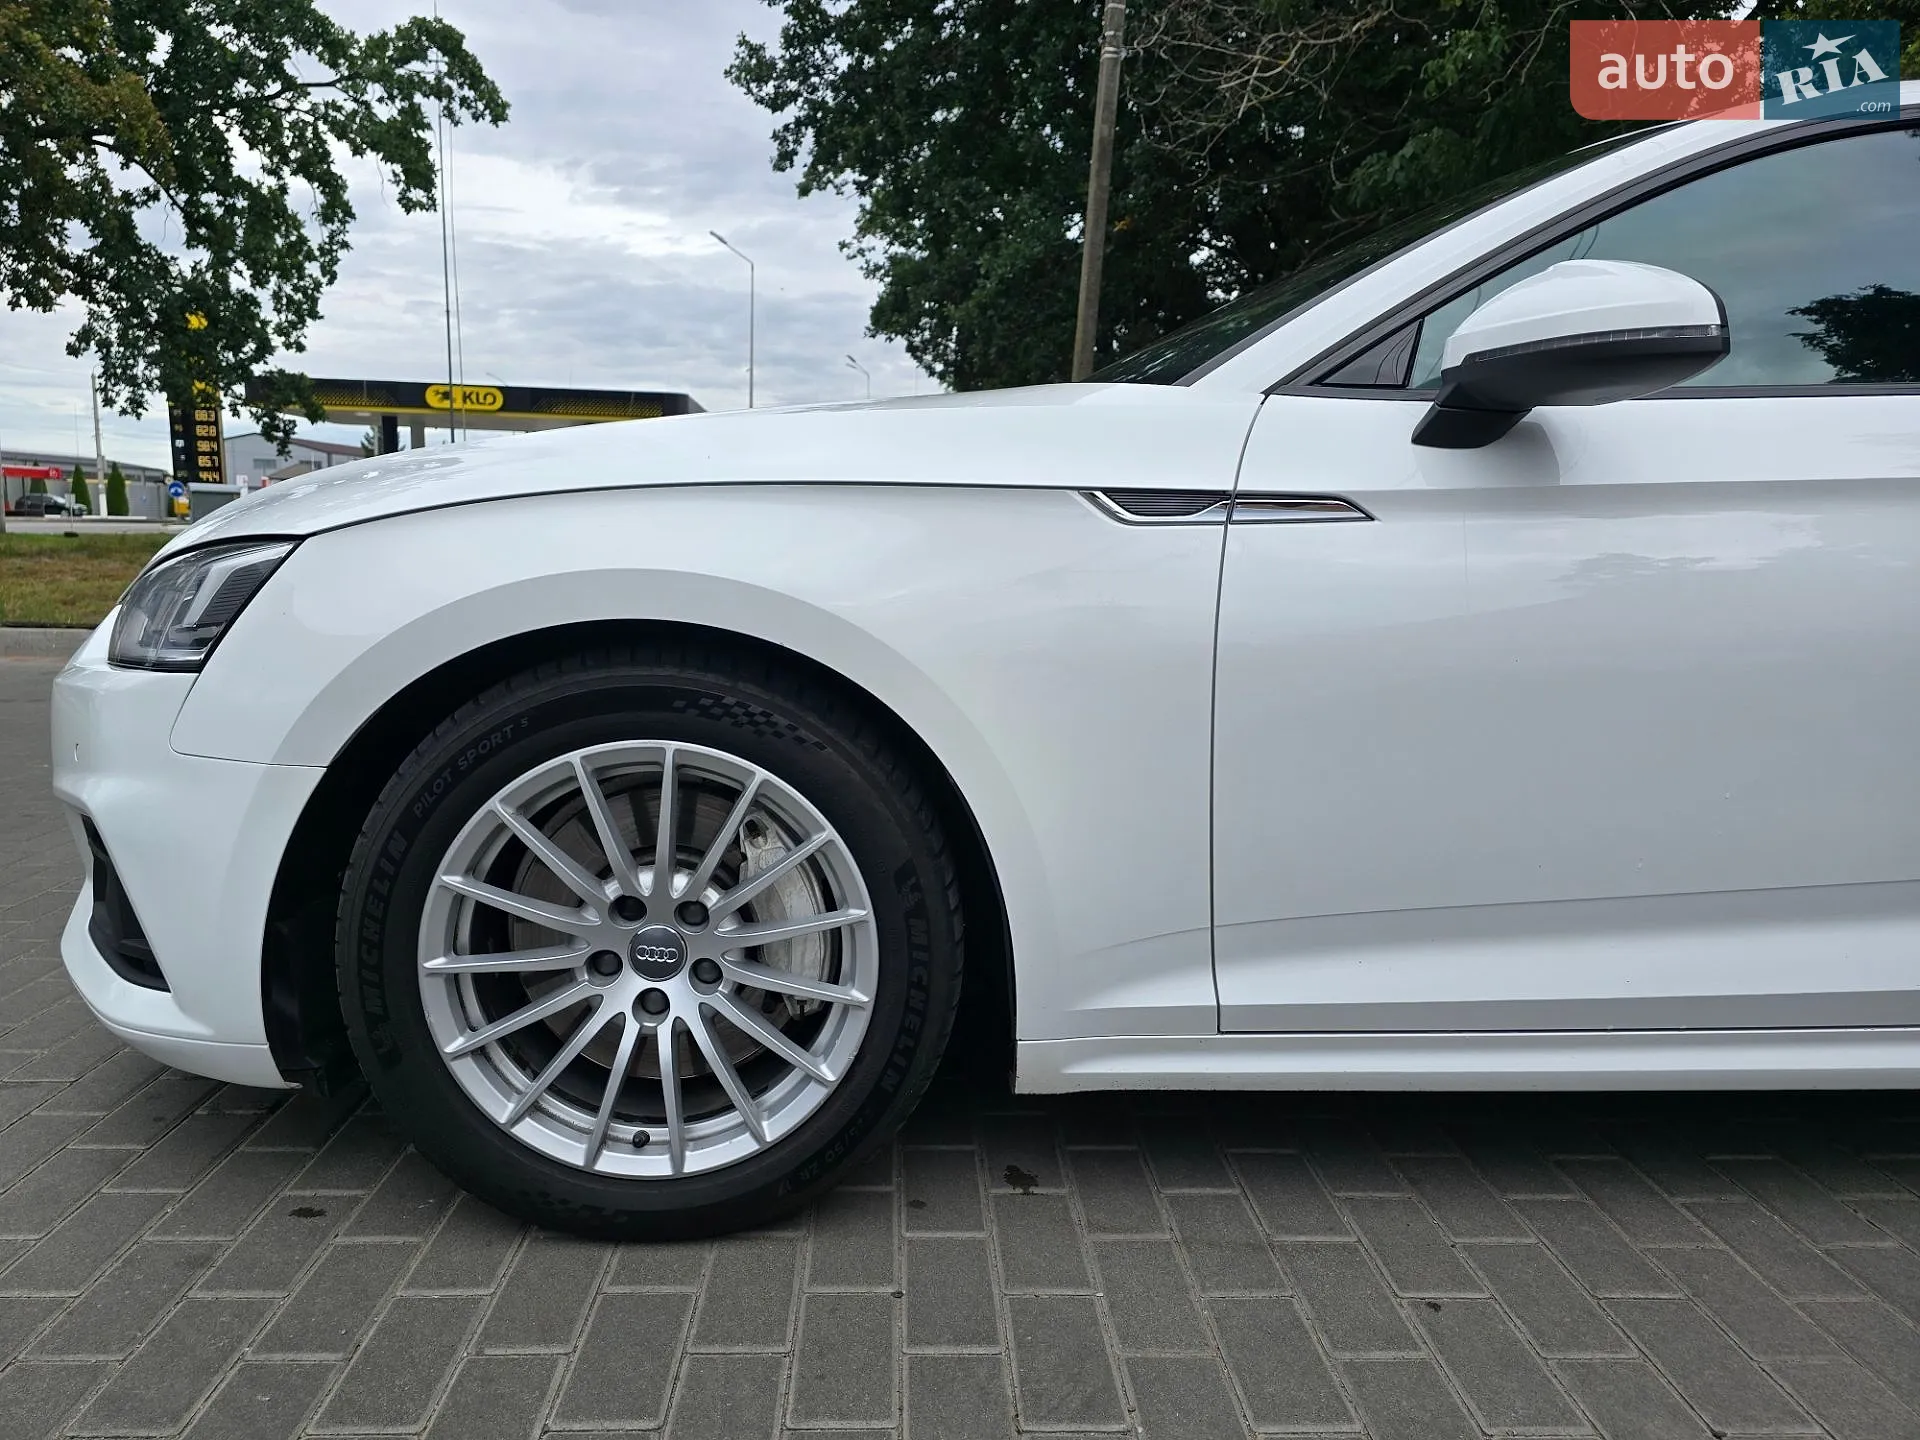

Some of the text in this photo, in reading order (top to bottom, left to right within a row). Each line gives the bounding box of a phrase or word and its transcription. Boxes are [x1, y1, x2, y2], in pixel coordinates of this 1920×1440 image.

[462, 391, 497, 405] KLO
[360, 829, 409, 1016] MICHELIN
[412, 769, 453, 819] PILOT
[458, 725, 515, 773] SPORT
[881, 917, 930, 1092] MICHELIN
